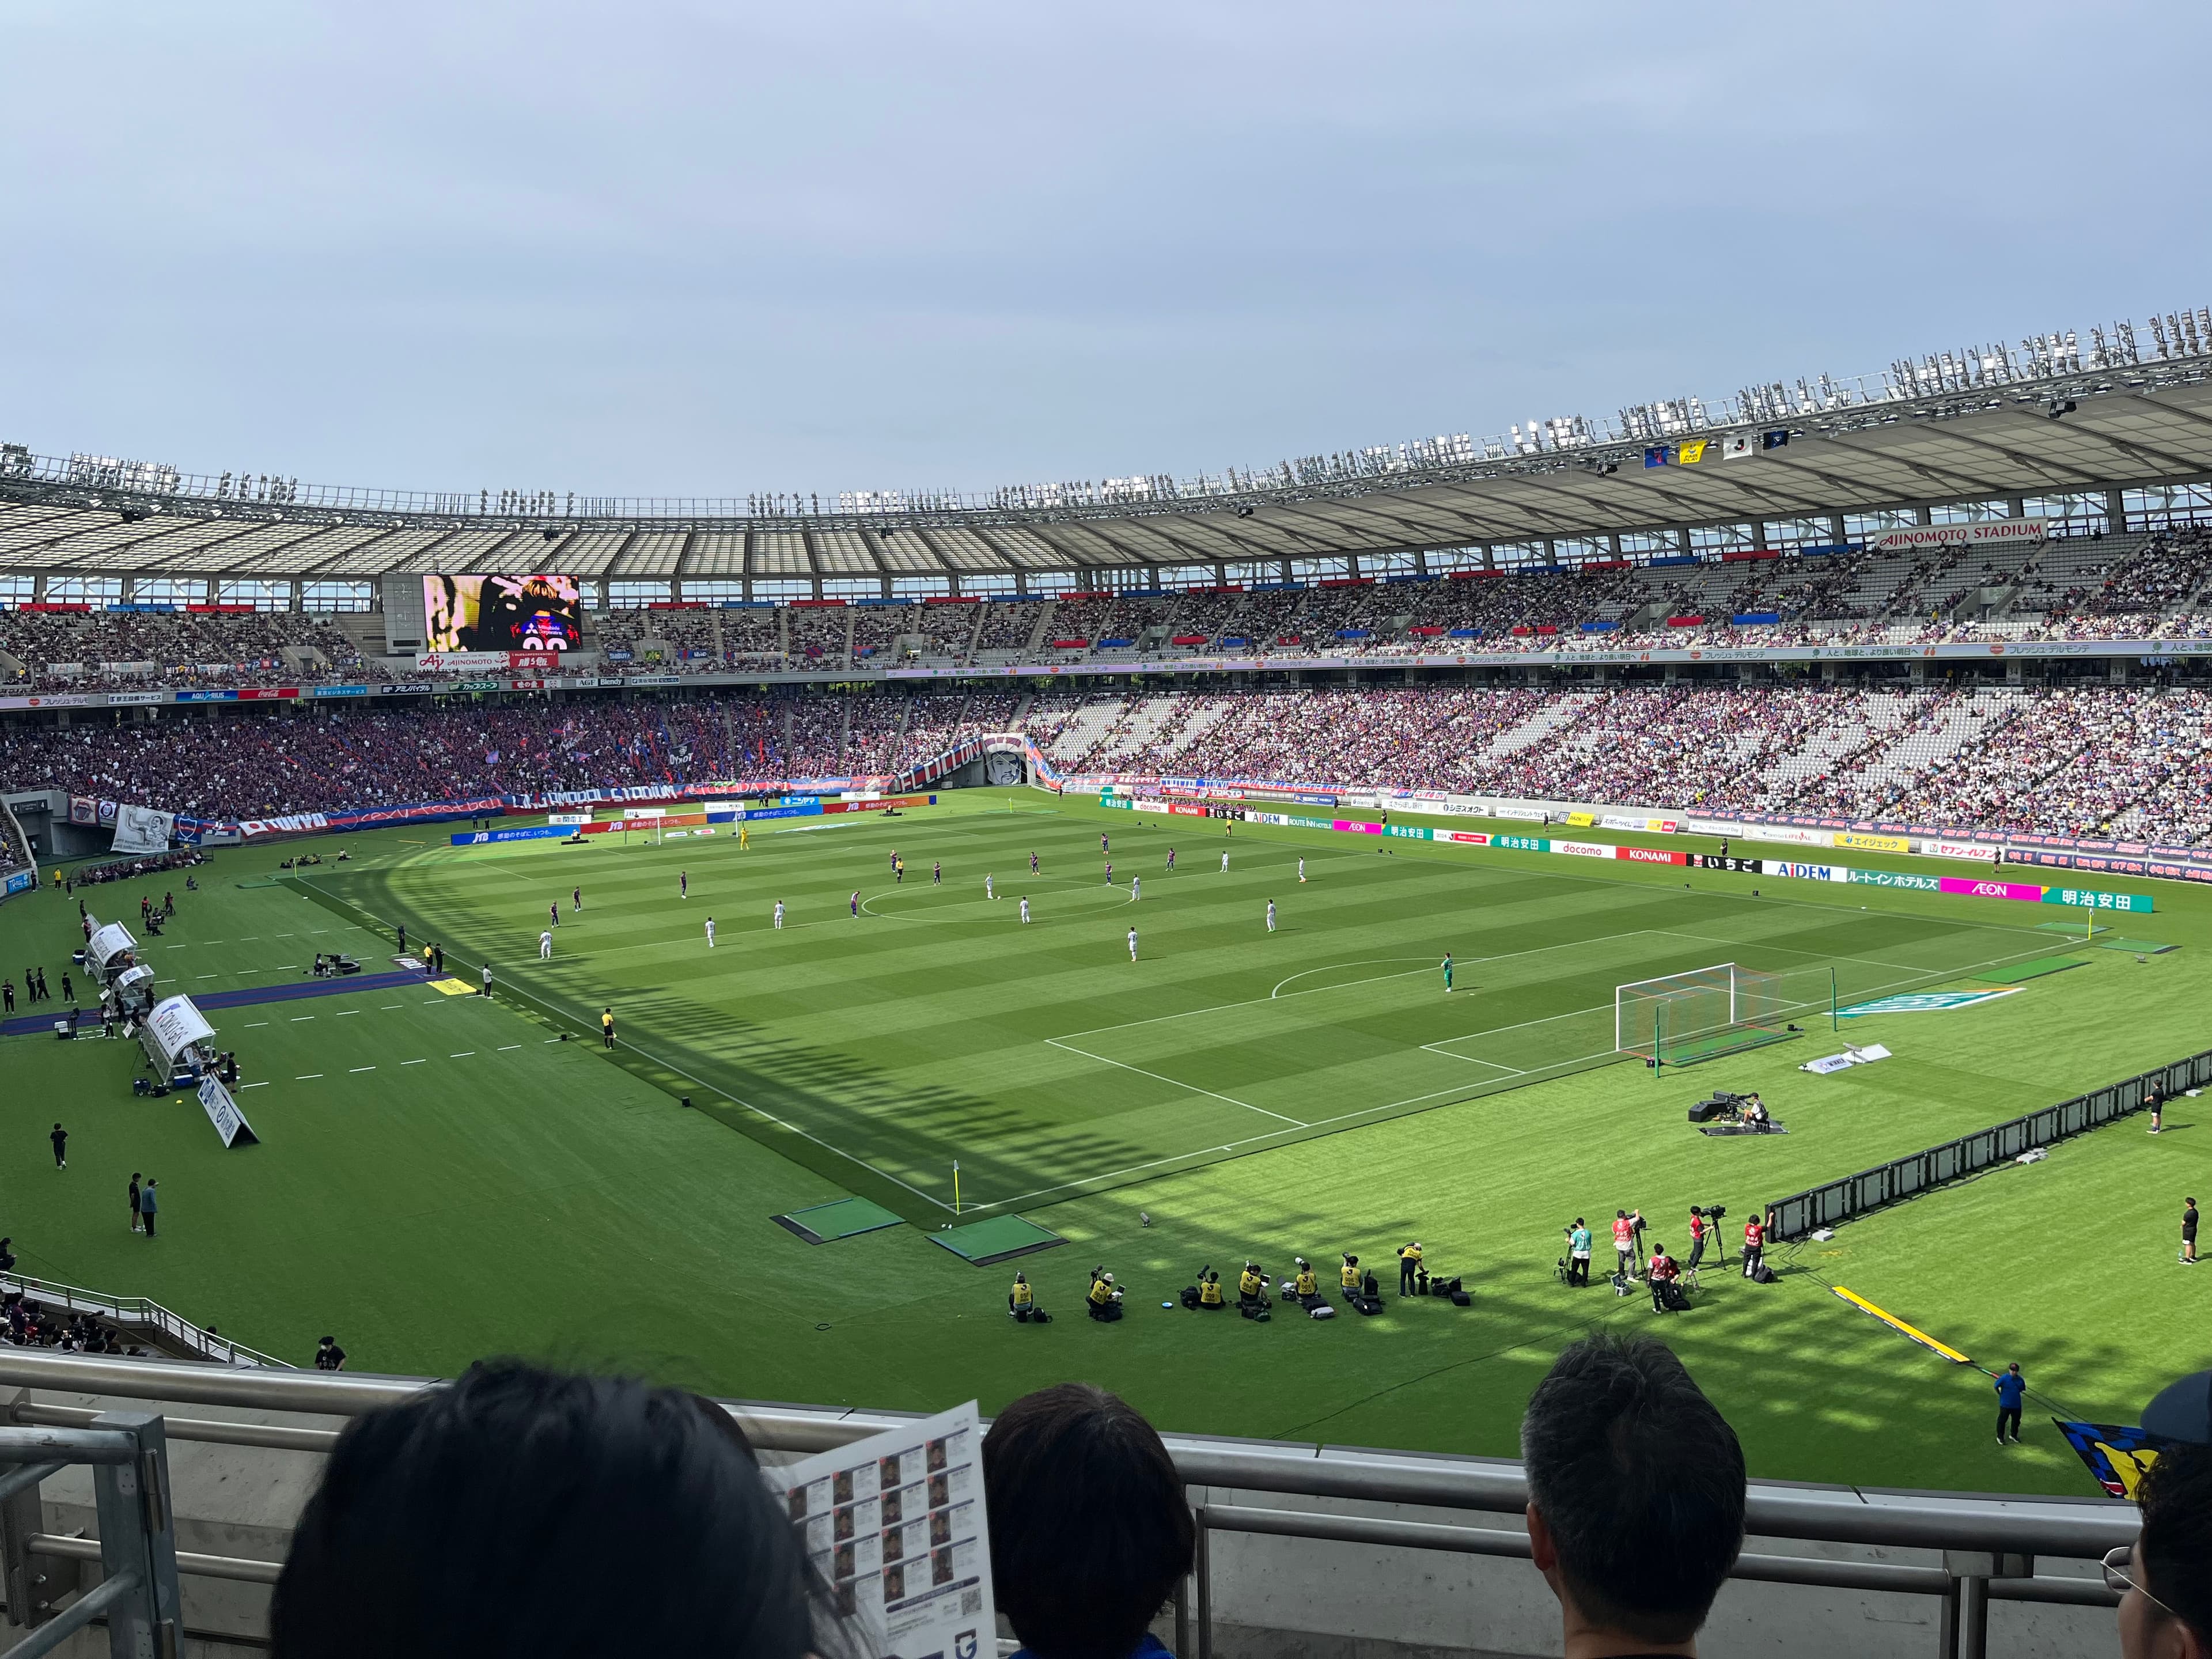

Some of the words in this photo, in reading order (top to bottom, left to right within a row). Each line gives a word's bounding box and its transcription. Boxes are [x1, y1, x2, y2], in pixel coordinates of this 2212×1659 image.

[1879, 529, 1967, 547] AJINOMOTO
[1974, 523, 2041, 540] STADIUM
[2008, 668, 2018, 676] 34
[395, 684, 430, 692] アミノバイタル
[462, 682, 498, 691] カップスープ
[192, 691, 224, 699] AQUARIUS
[611, 785, 677, 802] STADIUM
[846, 802, 859, 812] JTB
[1105, 799, 1127, 809] 明治安田
[1141, 804, 1161, 812] docomo
[1393, 800, 1423, 810] きらぼし銀行
[1176, 806, 1198, 815] KONAMI
[1449, 805, 1484, 814] シミズオクト
[1217, 810, 1241, 820] いちご
[264, 813, 328, 831] TOKYO
[608, 821, 623, 832] JTB
[1289, 819, 1305, 827] ROUTE
[474, 832, 489, 843] JTB
[497, 829, 552, 840] 感動のそばに、いつも。
[1391, 826, 1424, 839] 明治安田
[1501, 836, 1539, 850] 明治安田
[1854, 838, 1898, 848] エイジェック
[1563, 843, 1602, 855] docomo
[1629, 849, 1671, 863] KONAMI
[1708, 857, 1754, 872] いちご
[1848, 870, 1893, 885] ルートイン
[1894, 874, 1938, 891] ホテルズ
[2062, 889, 2131, 910] 明治安田
